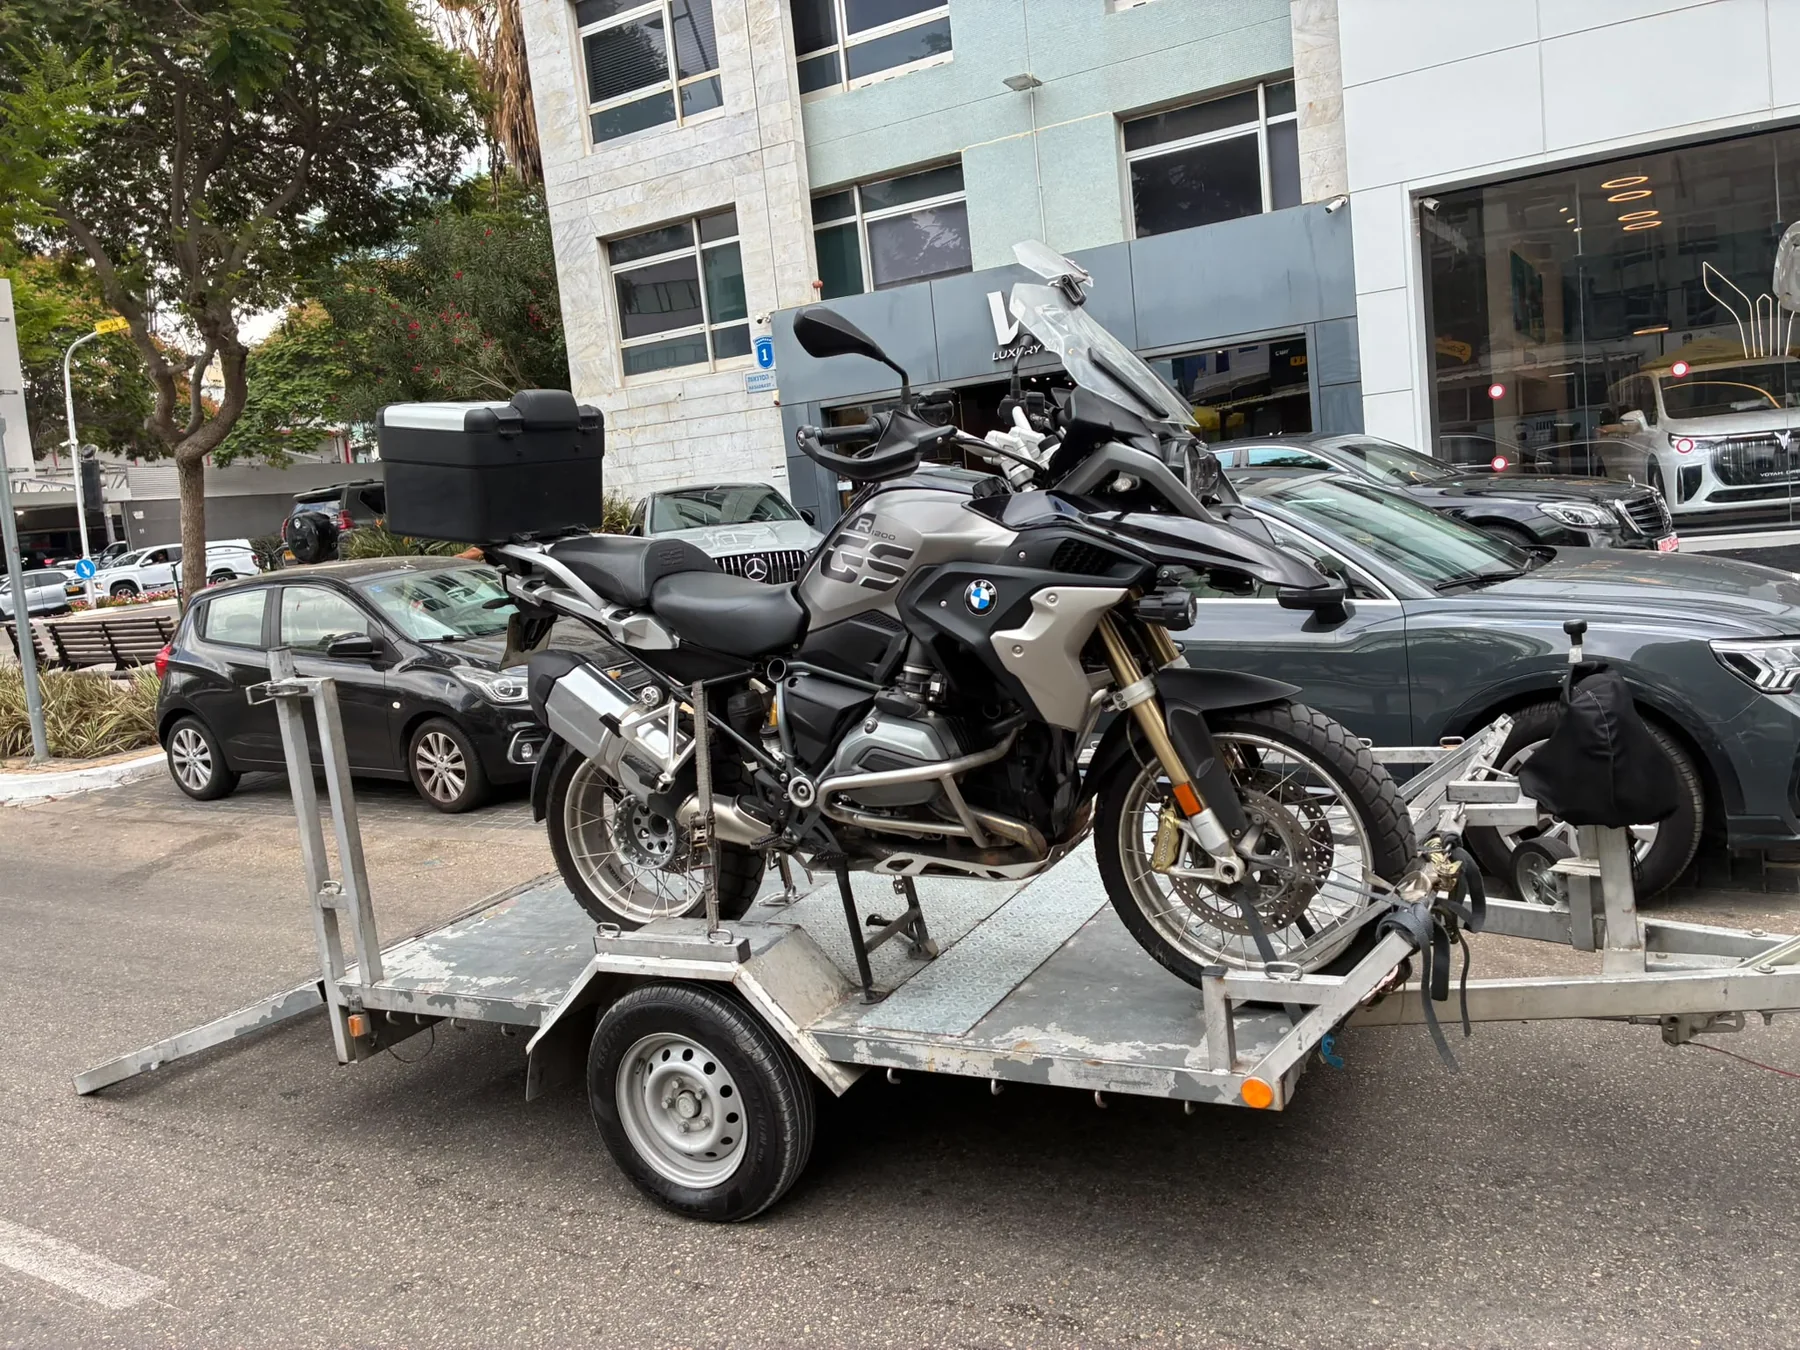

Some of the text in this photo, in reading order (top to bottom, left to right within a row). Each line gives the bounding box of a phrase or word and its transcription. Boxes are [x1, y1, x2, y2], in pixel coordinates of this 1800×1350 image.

[761, 348, 768, 361] 1
[854, 517, 896, 541] R 1200
[820, 531, 914, 592] GS
